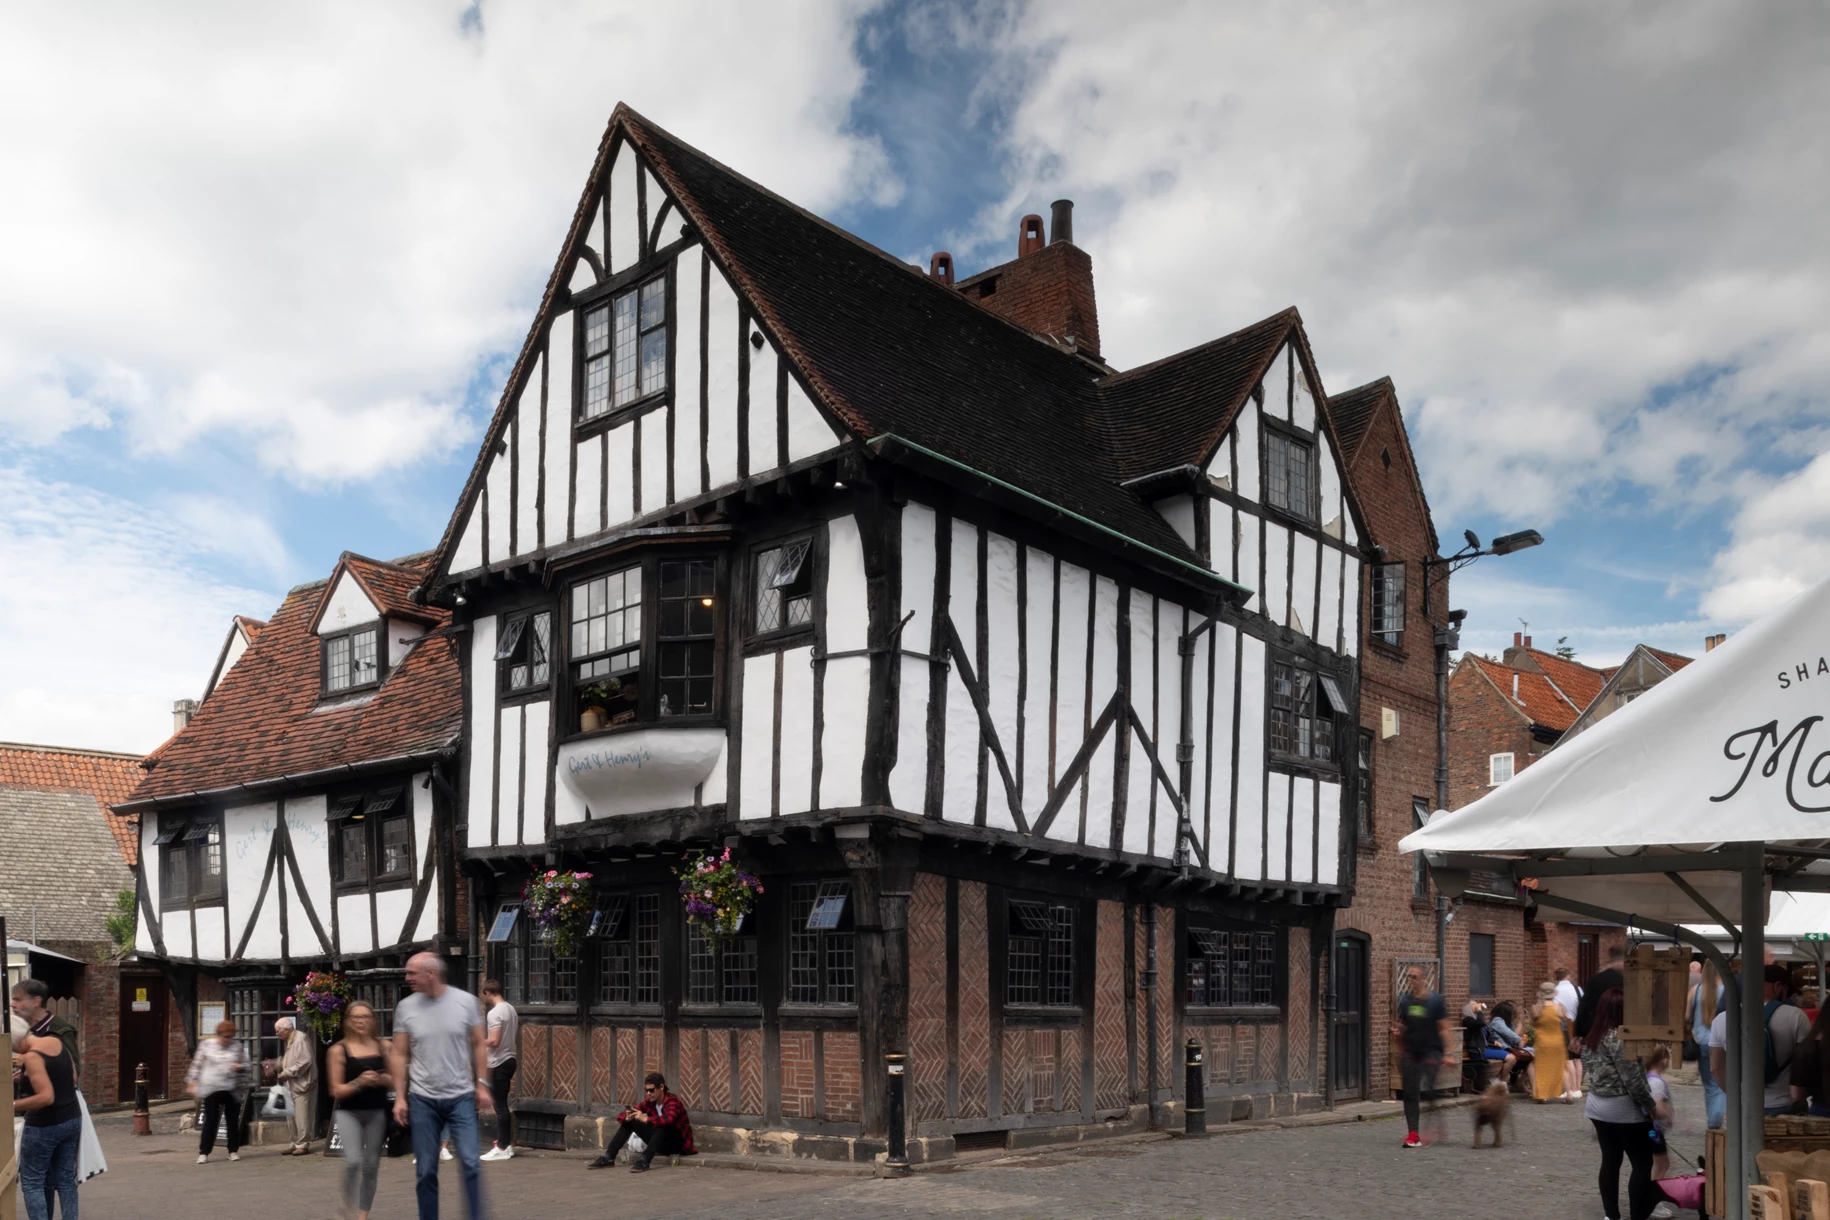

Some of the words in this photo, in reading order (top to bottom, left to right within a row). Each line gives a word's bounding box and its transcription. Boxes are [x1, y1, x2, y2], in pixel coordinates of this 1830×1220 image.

[1777, 656, 1830, 690] SHA
[568, 755, 592, 775] Gert
[591, 751, 603, 769] &
[604, 744, 650, 768] Henry's
[236, 825, 257, 861] Gert
[262, 817, 274, 838] &
[287, 811, 328, 849] Henry's
